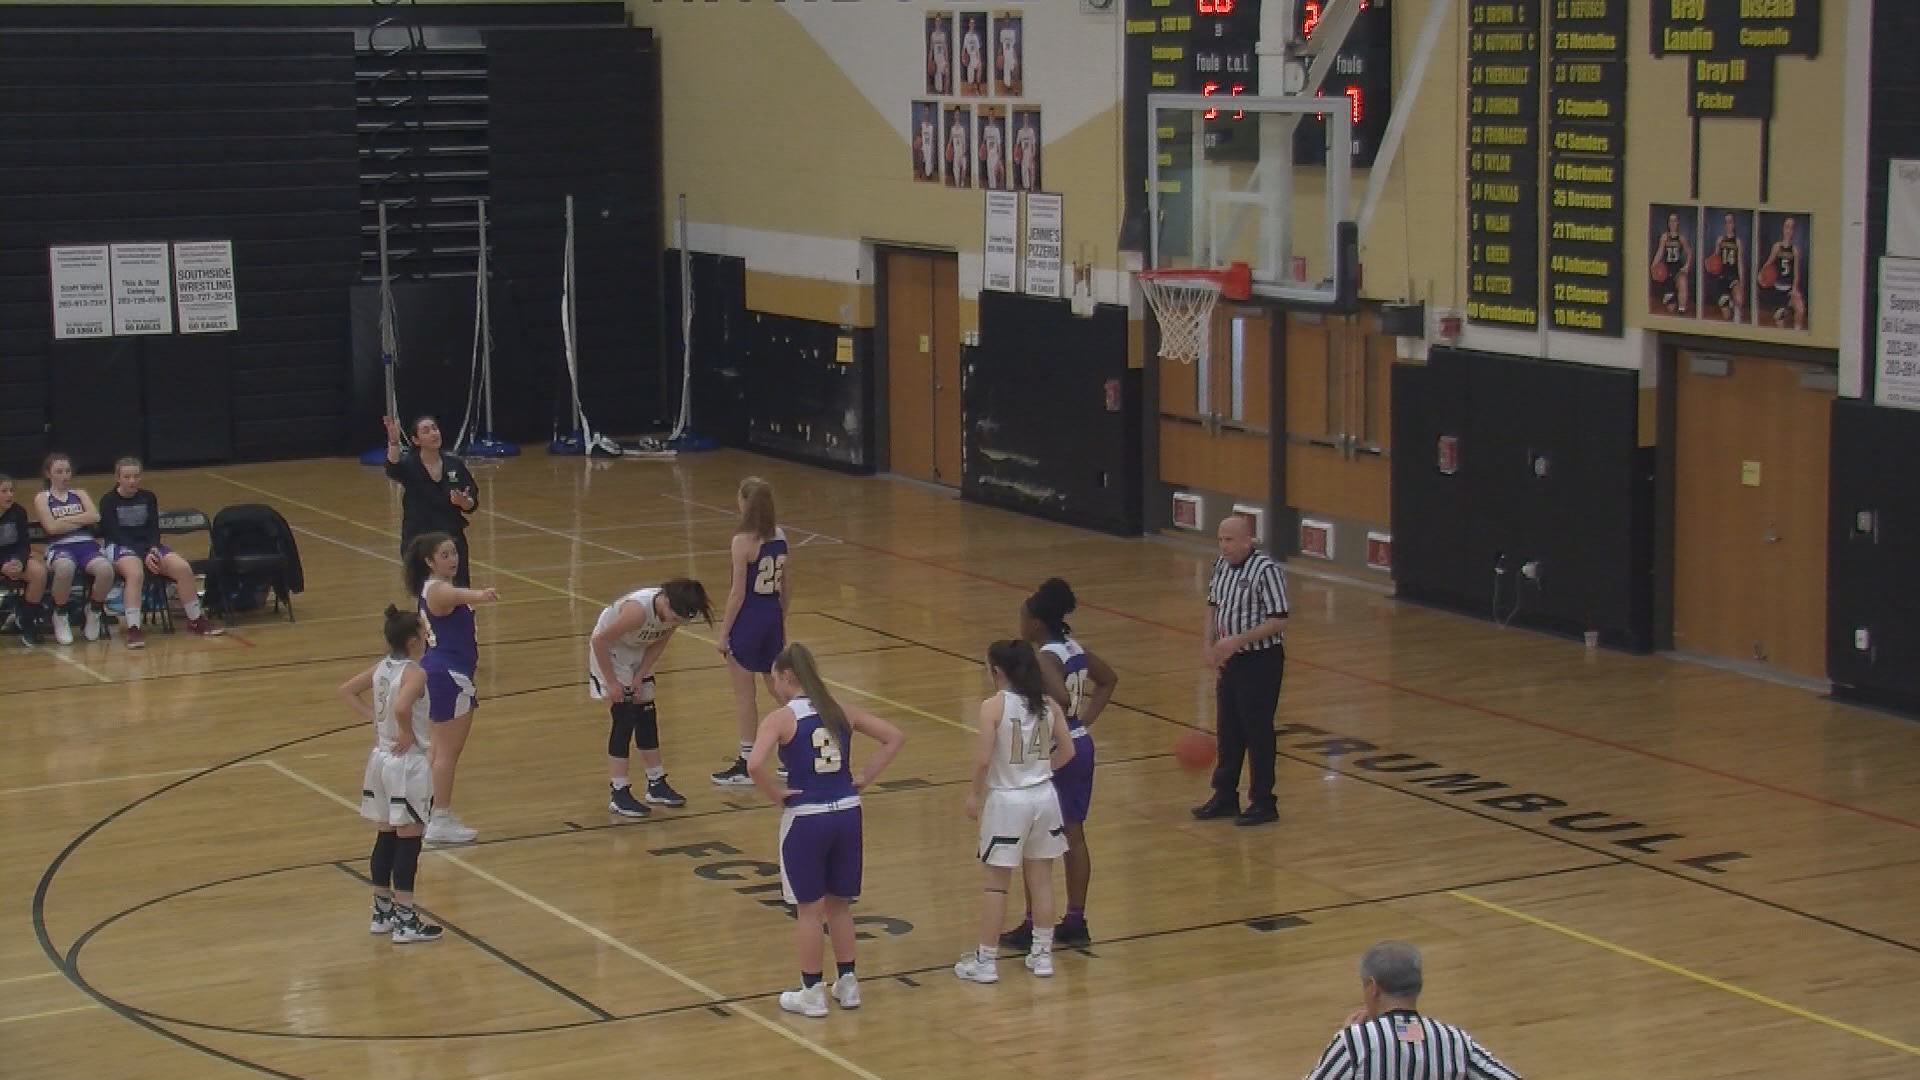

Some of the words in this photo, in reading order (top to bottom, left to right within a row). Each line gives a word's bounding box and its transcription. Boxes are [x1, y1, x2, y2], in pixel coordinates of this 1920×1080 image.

[1029, 228, 1060, 243] JENNIE'S
[1028, 243, 1060, 259] PIZZERIA
[178, 268, 231, 281] SOUTHSIDE
[179, 280, 232, 292] WRESTLING
[1009, 717, 1050, 765] 14
[811, 727, 842, 773] 3
